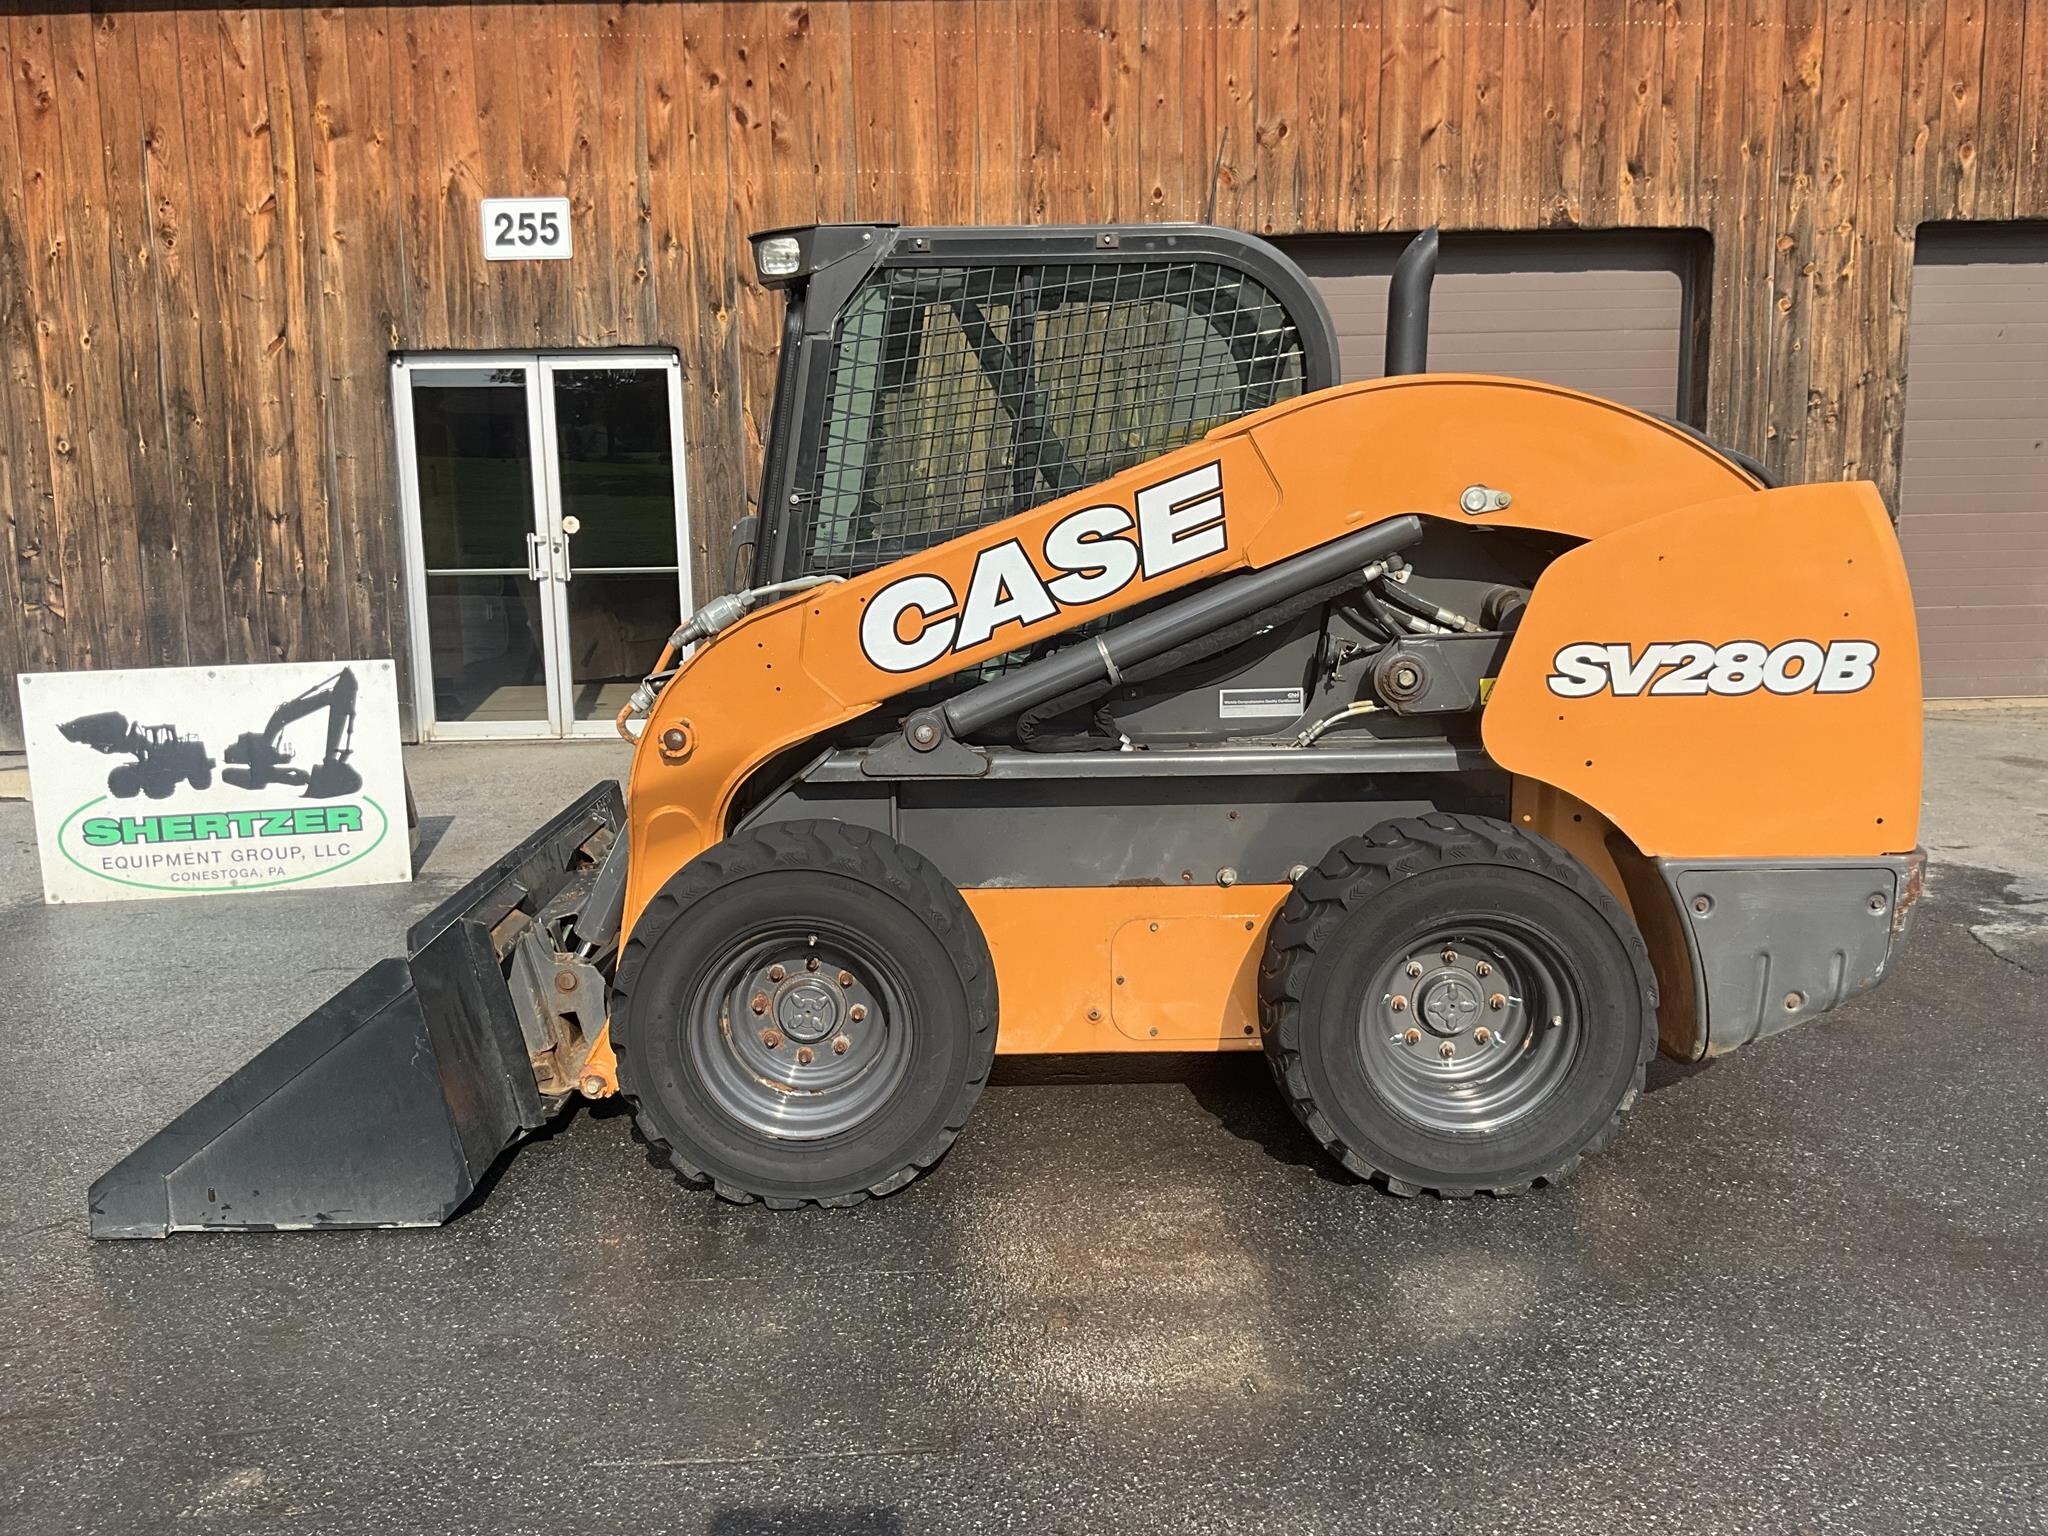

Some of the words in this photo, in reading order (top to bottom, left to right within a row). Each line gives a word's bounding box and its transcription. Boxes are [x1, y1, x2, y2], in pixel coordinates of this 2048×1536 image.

[494, 212, 560, 246] 255
[859, 459, 1228, 673] CASE
[1546, 639, 1880, 698] SV280B
[82, 805, 363, 846] SHERTZER
[102, 850, 221, 871] EQUIPMENT
[231, 846, 306, 863] GROUP,
[314, 843, 351, 857] LLC
[170, 868, 263, 883] CONESTOGA,
[268, 866, 286, 878] PA
